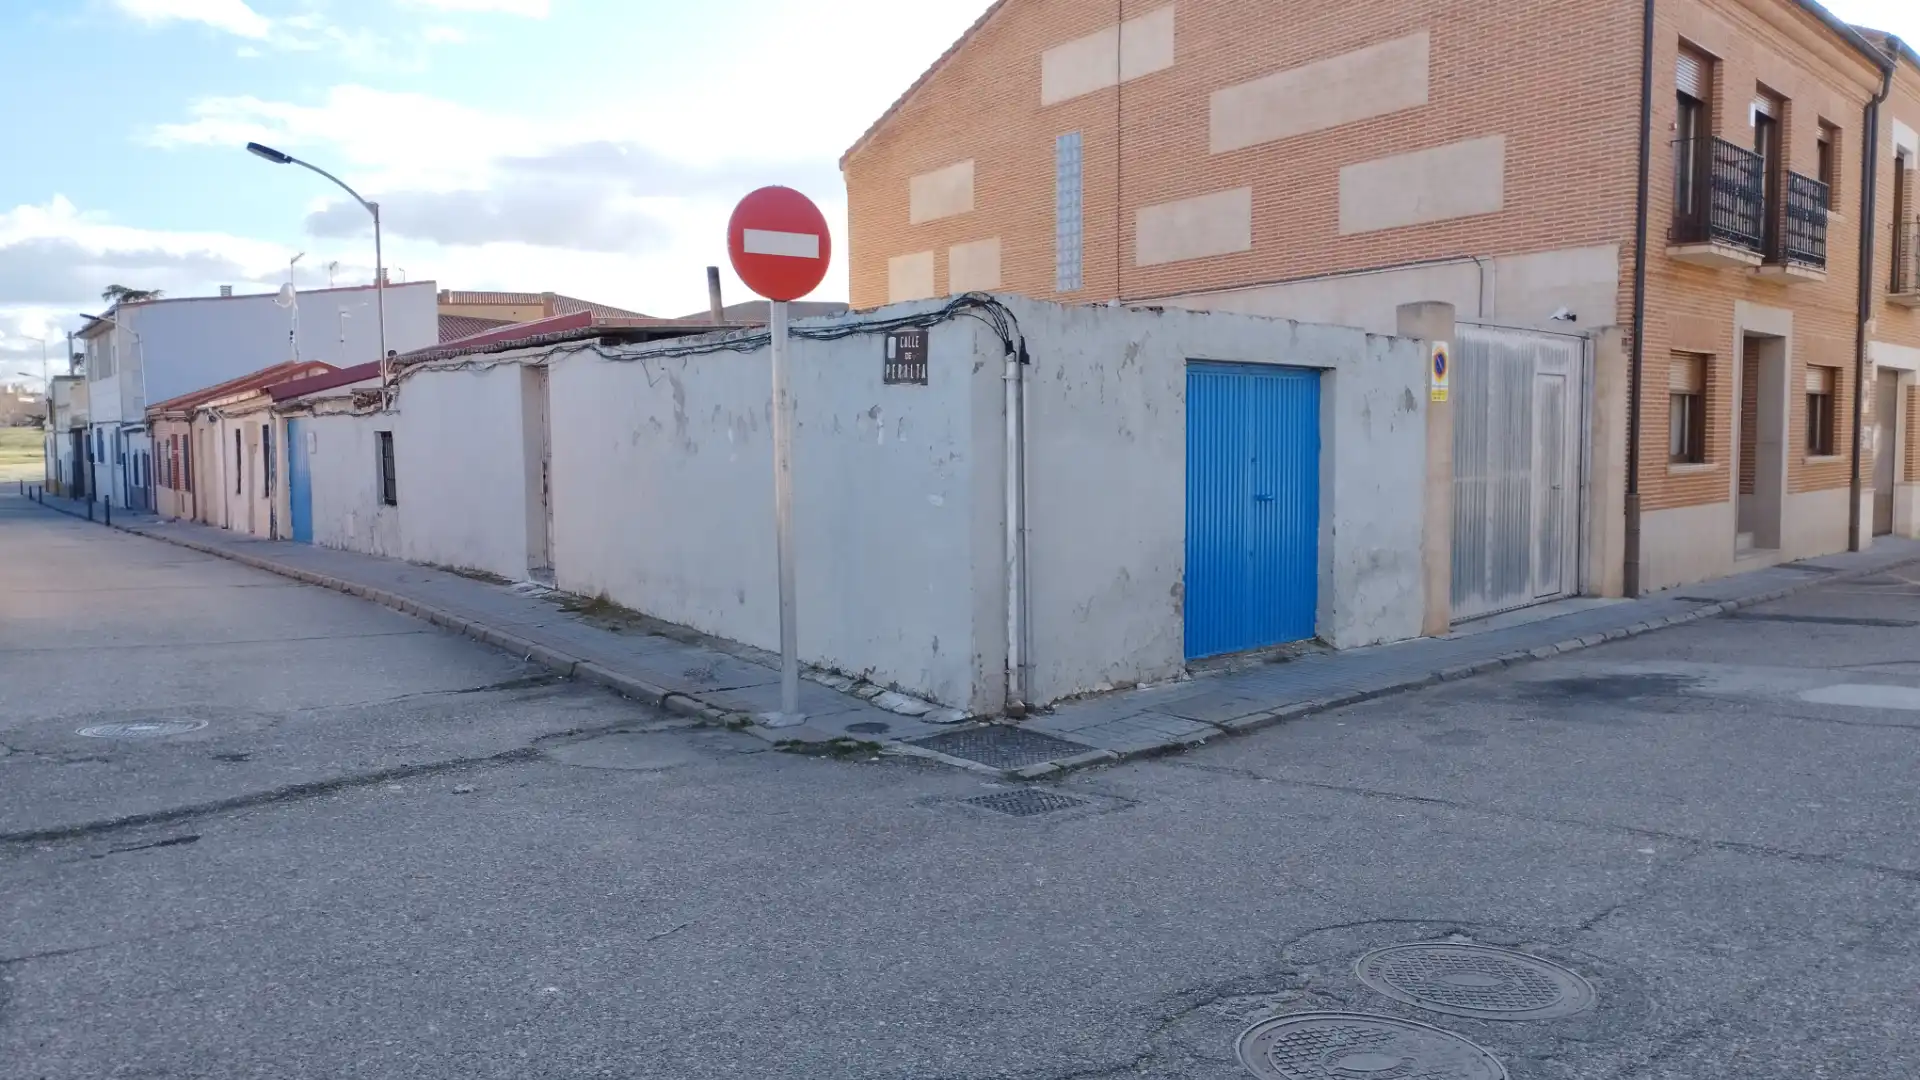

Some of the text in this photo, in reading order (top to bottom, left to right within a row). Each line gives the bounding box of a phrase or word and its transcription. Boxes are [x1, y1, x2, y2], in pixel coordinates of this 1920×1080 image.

[900, 335, 919, 348] CALLE
[904, 352, 912, 360] DE
[886, 364, 926, 379] PERALTA
